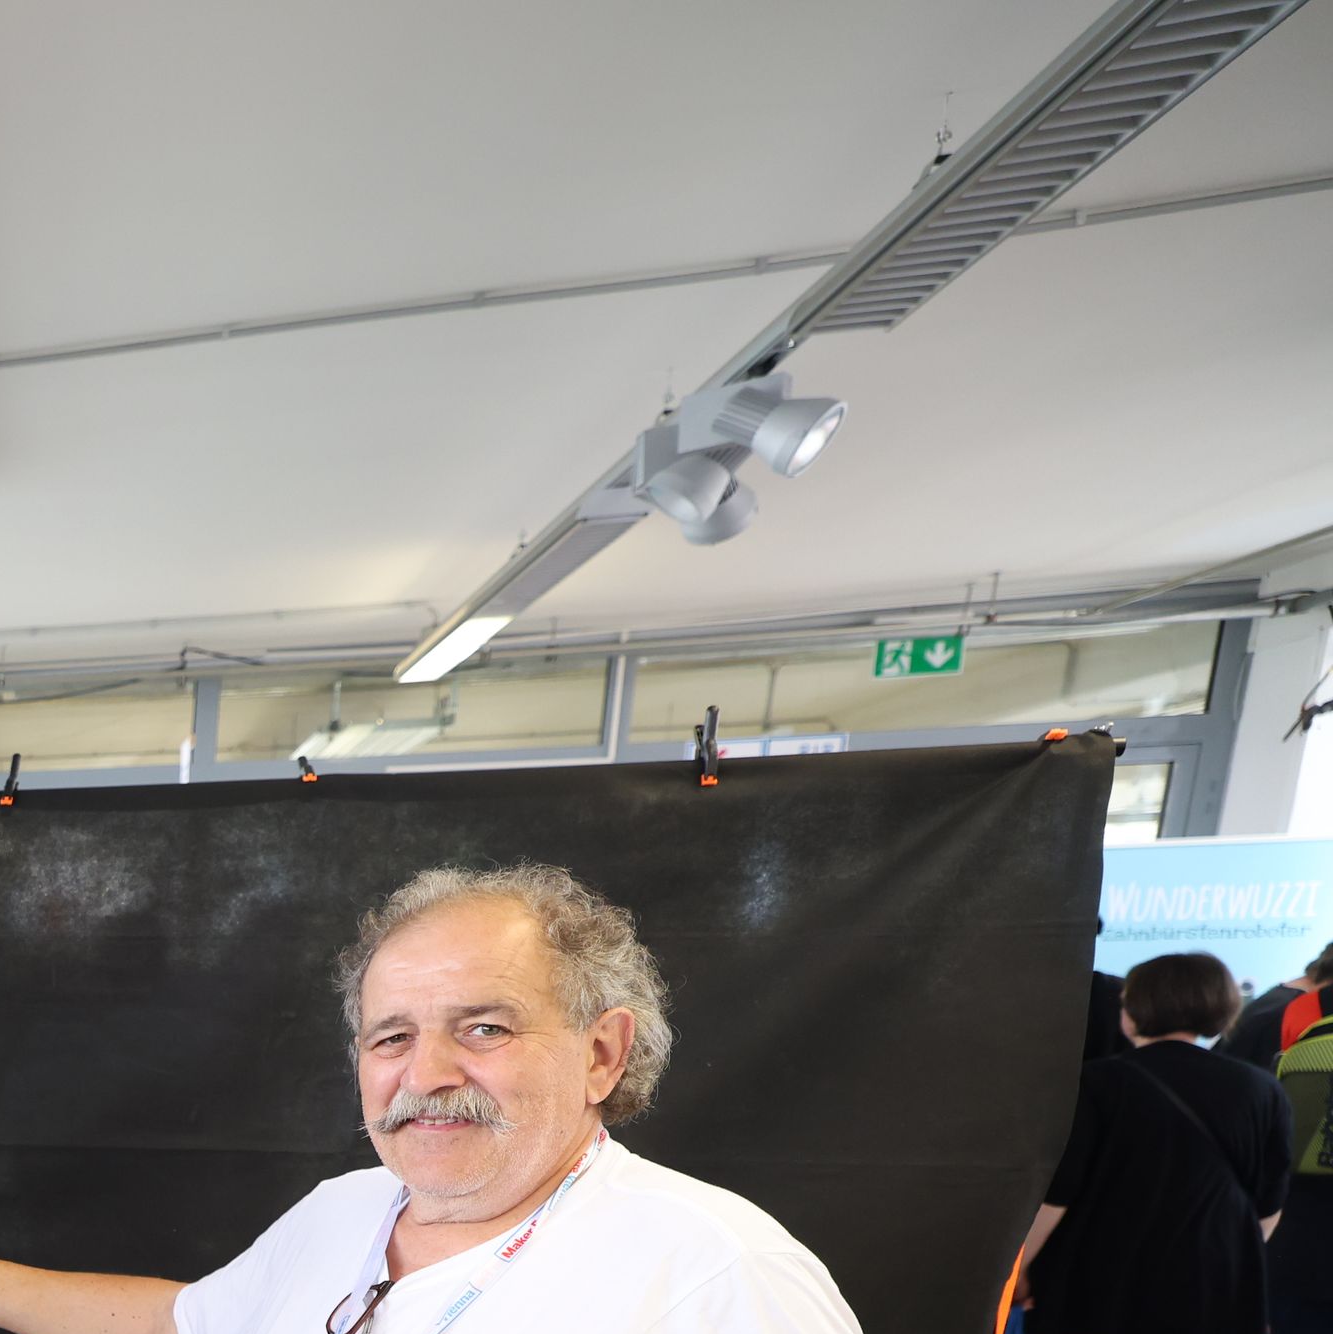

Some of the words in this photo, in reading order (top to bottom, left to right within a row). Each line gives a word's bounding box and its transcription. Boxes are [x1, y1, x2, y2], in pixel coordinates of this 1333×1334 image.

[1107, 880, 1323, 923] WUNDERWUZZI
[501, 1228, 533, 1259] Maker
[444, 1289, 475, 1322] ienna
